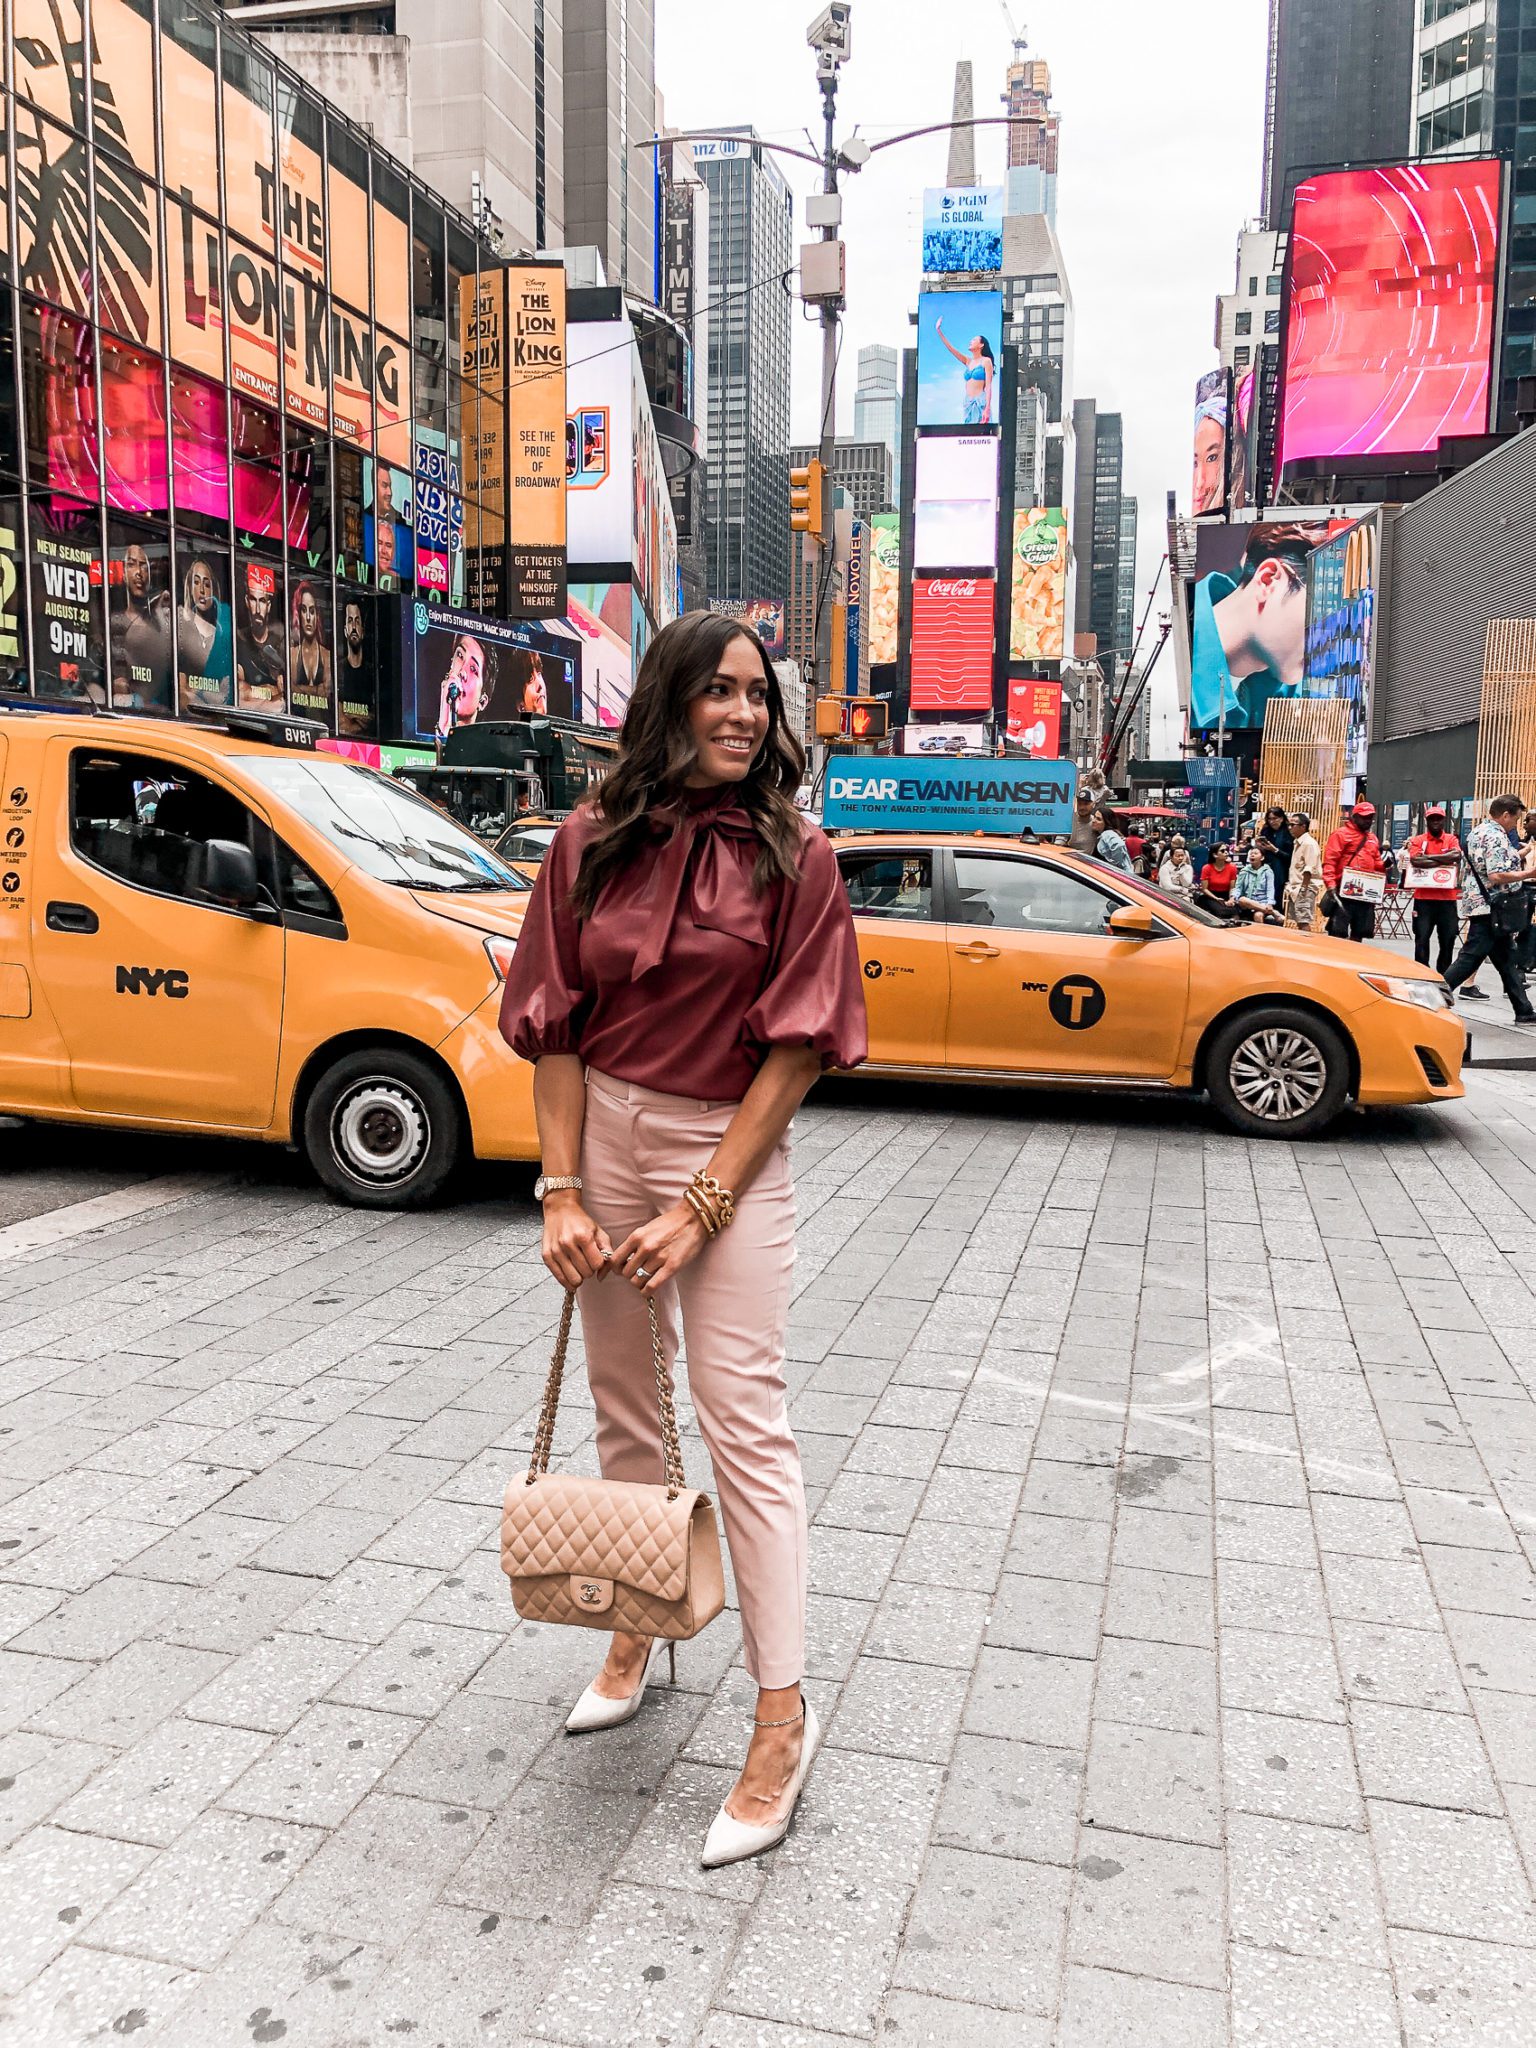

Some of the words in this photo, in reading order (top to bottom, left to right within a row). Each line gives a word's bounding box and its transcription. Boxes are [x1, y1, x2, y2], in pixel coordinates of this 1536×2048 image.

[958, 194, 987, 206] PGIM
[255, 161, 323, 258] THE
[942, 212, 950, 223] IS
[952, 210, 984, 222] GLOBAL
[180, 185, 297, 351] LION
[303, 267, 399, 407] KING
[521, 294, 549, 308] THE
[516, 312, 556, 336] LION
[514, 338, 562, 366] KING
[235, 368, 278, 398] ENTRANCE
[288, 395, 302, 410] ON
[306, 402, 324, 420] 45TH
[334, 416, 356, 434] STREET
[520, 430, 536, 442] SEE
[540, 430, 556, 442] THE
[524, 446, 551, 457] PRIDE
[532, 462, 544, 472] OF
[515, 476, 560, 488] BROADWAY
[36, 538, 57, 556] NEW
[60, 546, 92, 565] SEASON
[1022, 544, 1057, 552] Green
[514, 556, 529, 566] GET
[531, 556, 563, 566] TICKETS
[1026, 552, 1057, 562] Giant
[526, 570, 536, 580] AT
[537, 570, 551, 580] THE
[848, 530, 862, 606] NOVOTEL
[42, 562, 90, 604] WED
[519, 583, 558, 593] MINSKOFF
[928, 579, 978, 596] Coca-Cola
[522, 596, 555, 606] THEATRE
[45, 601, 78, 620] AUGUST
[80, 610, 90, 623] 28
[428, 609, 442, 623] Enjoy
[442, 613, 452, 624] BTS
[453, 616, 463, 626] 5TH
[50, 620, 86, 658] 9PM
[131, 665, 152, 682] THEO
[188, 675, 220, 692] GEORGIA
[292, 692, 309, 707] CARA
[830, 778, 898, 800] DEAR
[840, 803, 858, 812] THE
[862, 804, 888, 812] TONY
[890, 805, 975, 814] AWARD-WINNING
[979, 807, 1004, 815] BEST
[1008, 808, 1054, 817] MUSICAL
[116, 965, 189, 998] NYC
[1022, 982, 1048, 992] NYC
[1062, 985, 1094, 1022] T
